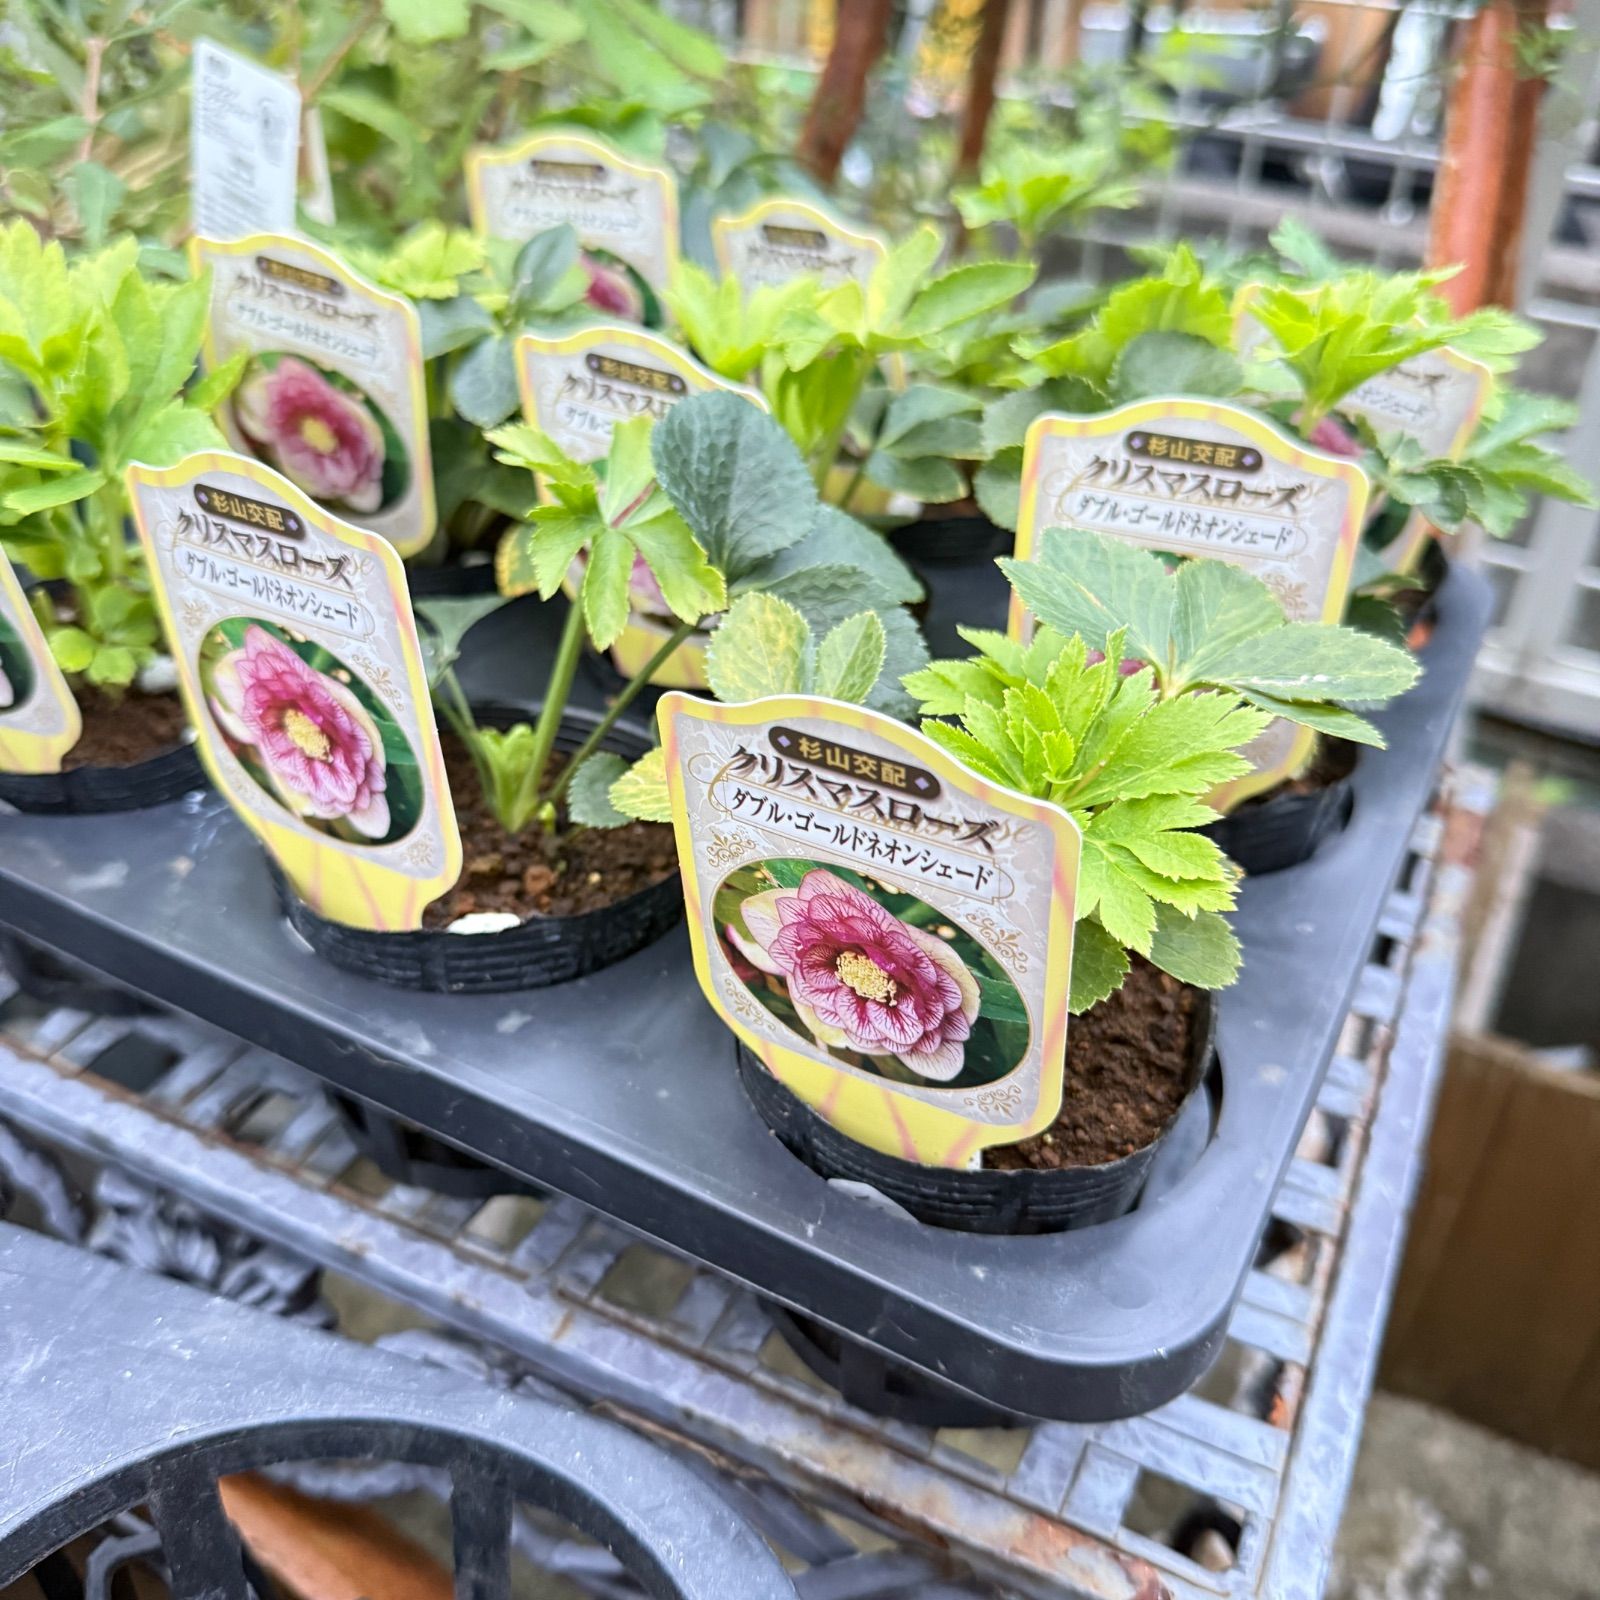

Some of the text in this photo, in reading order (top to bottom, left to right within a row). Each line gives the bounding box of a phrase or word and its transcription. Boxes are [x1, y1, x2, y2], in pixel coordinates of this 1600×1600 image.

[1148, 437, 1238, 468] 杉山交配
[211, 491, 286, 532] 杉山交配
[1083, 455, 1306, 514] クリスマスローズ
[177, 506, 354, 589] クリスマスローズ
[797, 738, 907, 789] 杉山交配
[729, 745, 998, 852] クリスマスローズ
[730, 787, 992, 892] ダブル・ゴールドネオンシェード
